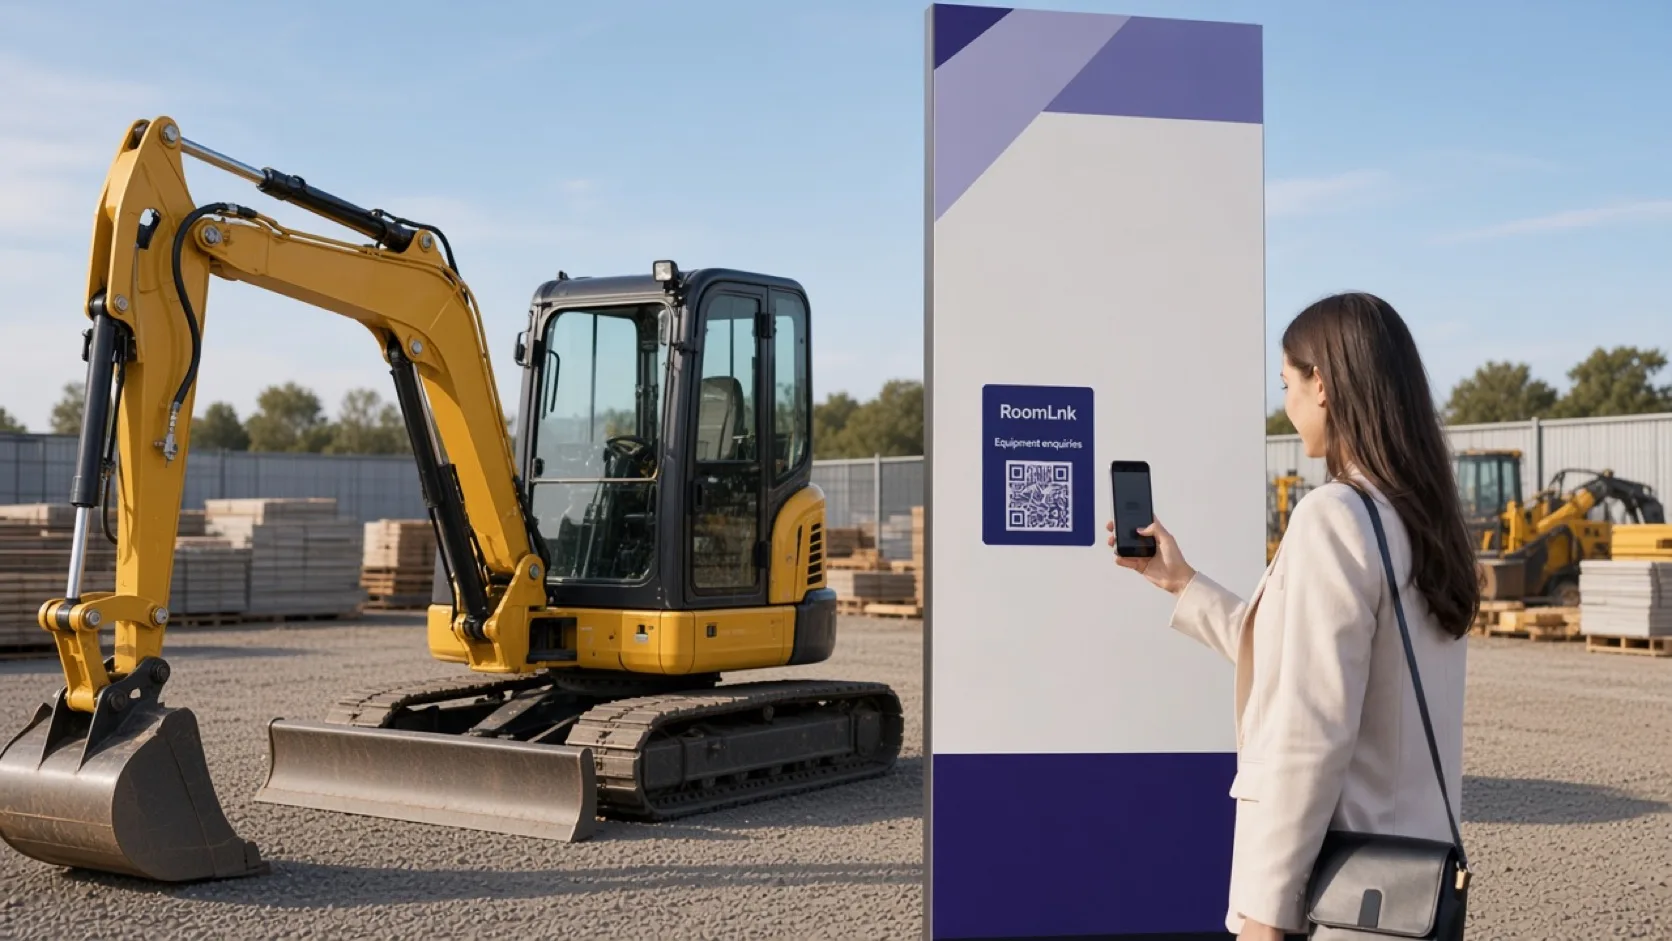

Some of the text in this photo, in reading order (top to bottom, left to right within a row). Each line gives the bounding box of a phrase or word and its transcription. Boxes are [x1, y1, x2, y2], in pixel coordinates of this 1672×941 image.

[1000, 404, 1077, 421] RoomLnk
[994, 437, 1083, 451] Equipment enquiries
